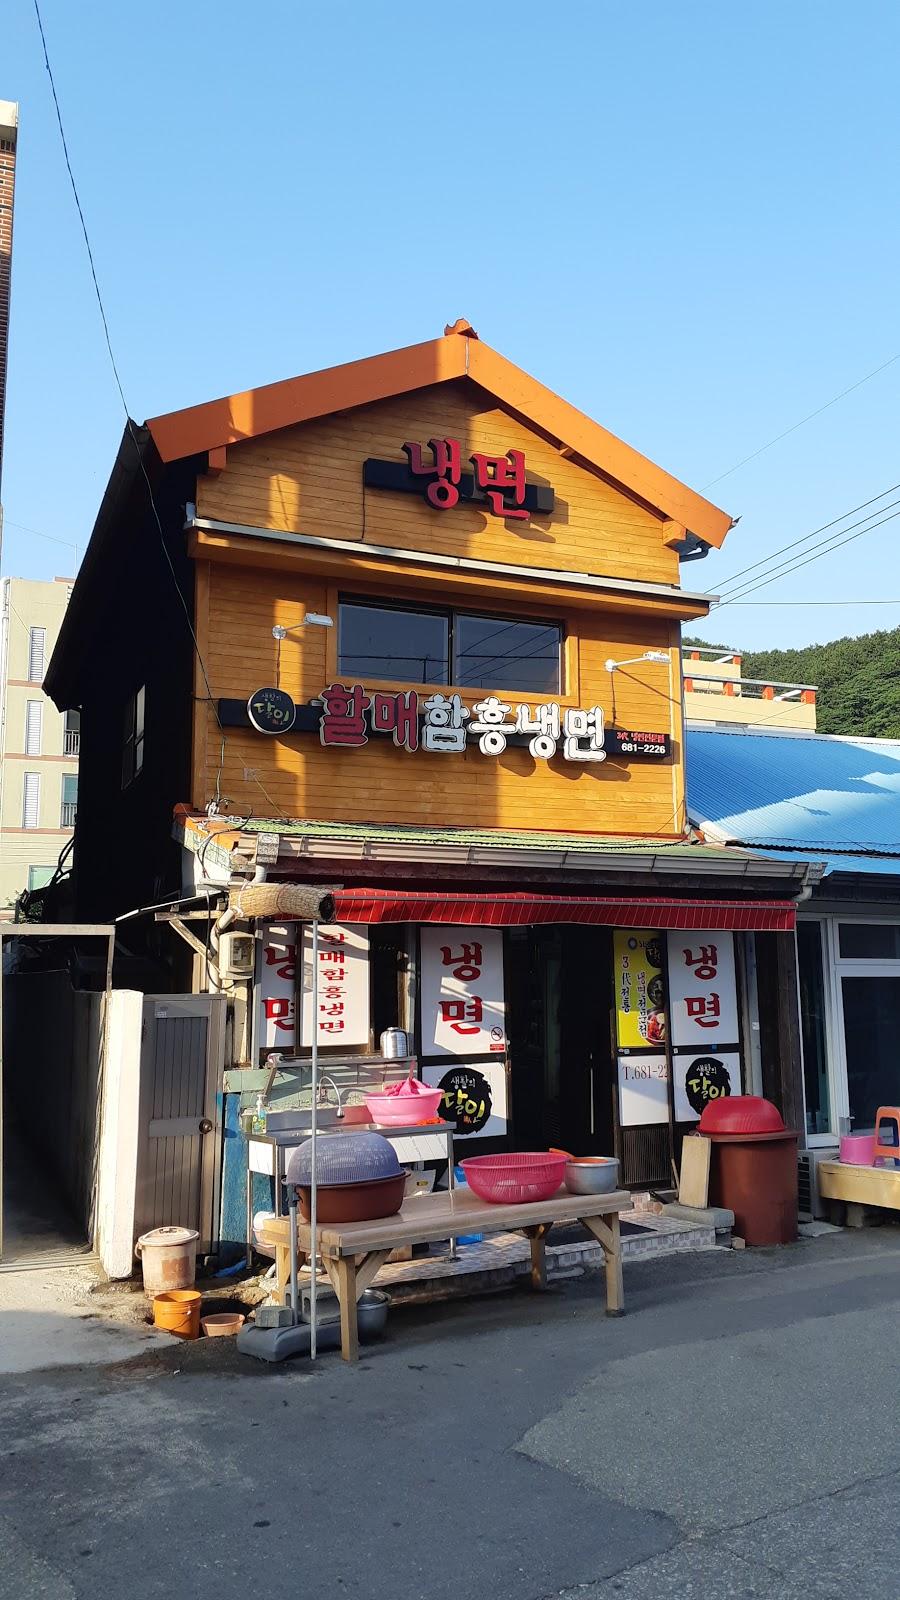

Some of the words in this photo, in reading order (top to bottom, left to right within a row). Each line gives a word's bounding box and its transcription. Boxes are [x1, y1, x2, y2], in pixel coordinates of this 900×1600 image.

[402, 438, 531, 520] 냉면
[318, 683, 607, 762] 할매함흥냉면
[621, 742, 666, 755] 681-2226
[438, 941, 483, 1035] 냉면
[682, 944, 721, 1028] 냉면
[696, 1063, 718, 1077] 생활의
